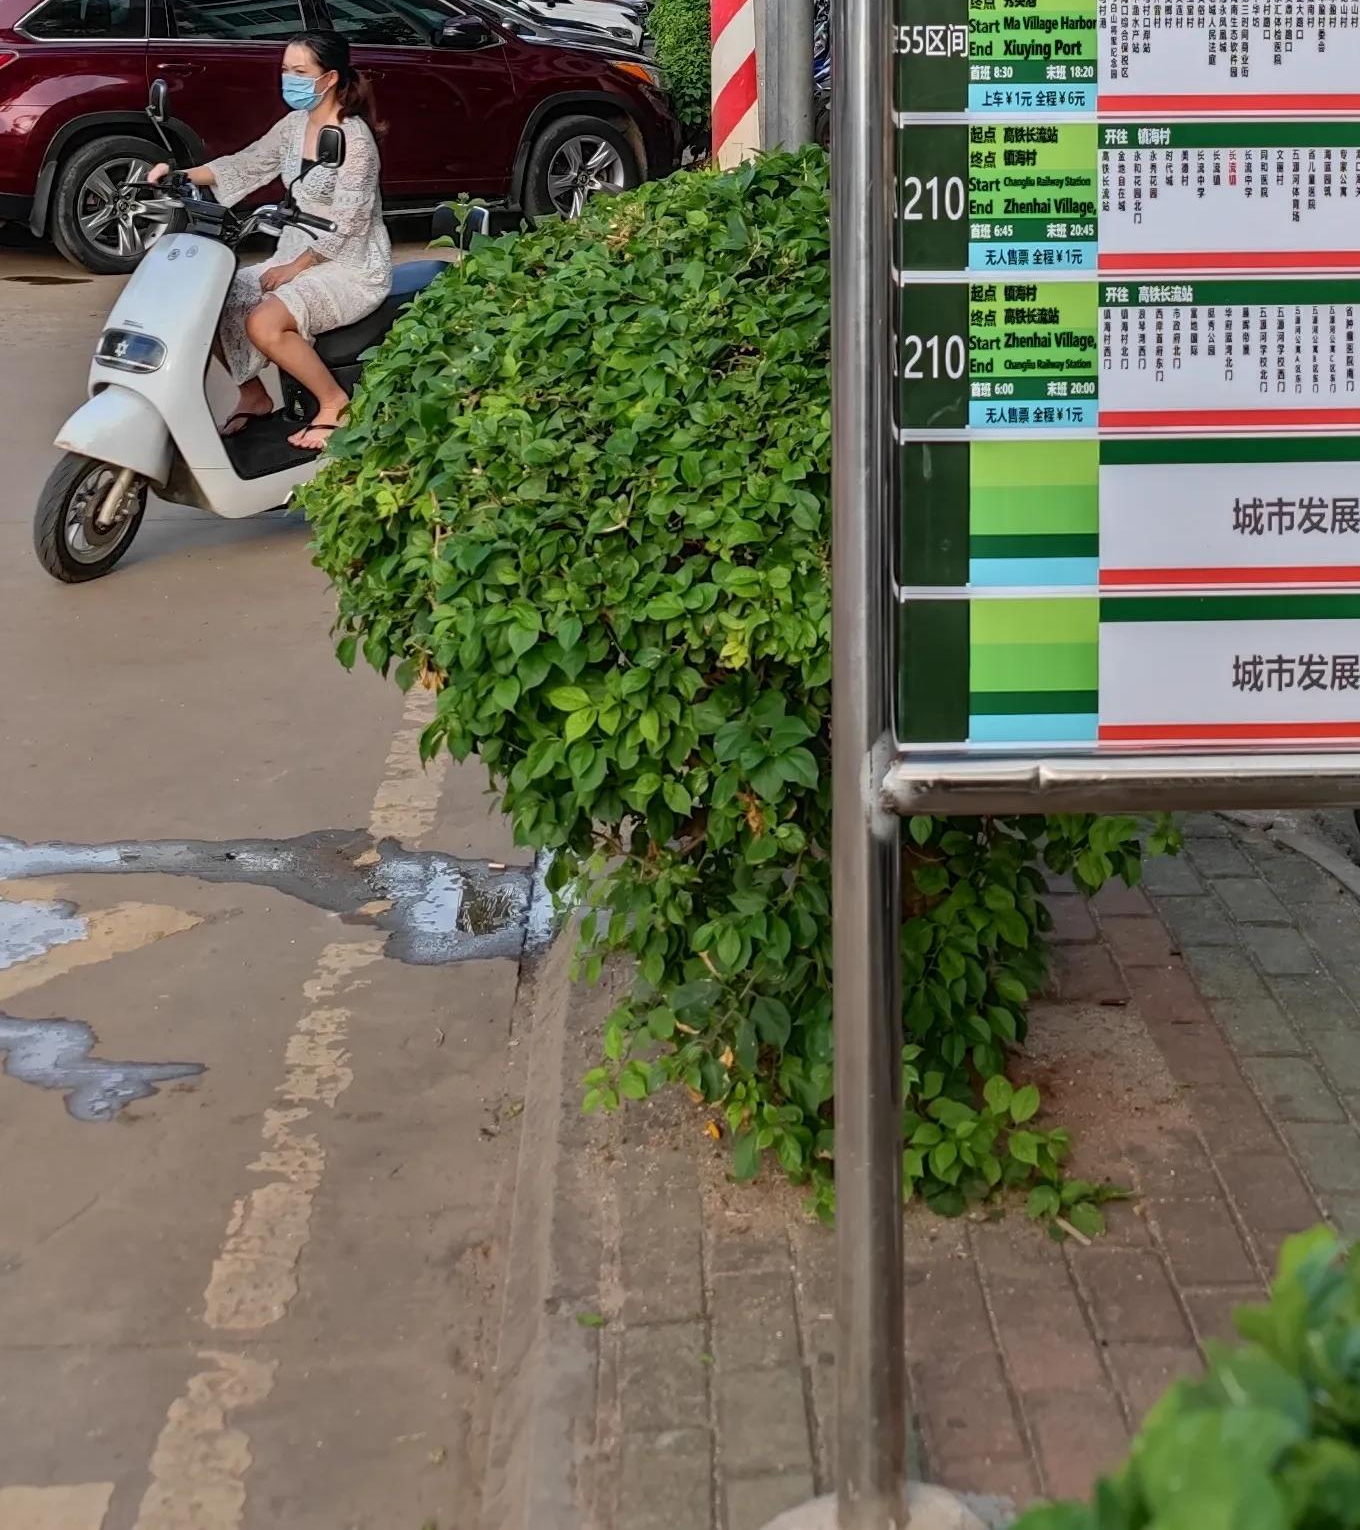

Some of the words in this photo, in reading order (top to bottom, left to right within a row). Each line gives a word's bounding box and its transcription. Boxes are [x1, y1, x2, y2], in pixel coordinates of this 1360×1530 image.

[969, 19, 1000, 33] Start
[1004, 17, 1020, 31] Ma
[1022, 16, 1058, 34] Village
[1061, 16, 1097, 29] Harbor
[900, 24, 968, 57] 55区间
[969, 42, 992, 57] End
[1003, 40, 1051, 60] Xiuying
[1055, 40, 1082, 56] Port
[994, 67, 1013, 79] 8:30
[1070, 66, 1094, 78] 18:20
[971, 127, 996, 143] 起点
[1003, 126, 1058, 143] 高铁长流站
[1105, 128, 1128, 145] 开往
[1138, 128, 1171, 145] 镇海村
[971, 151, 996, 168] 终点
[1004, 150, 1037, 167] 镇海村
[969, 178, 1000, 192] Start
[903, 176, 965, 221] 210
[970, 200, 993, 215] End
[1004, 198, 1051, 213] Zhenhai
[994, 225, 1013, 237] 6:45
[1070, 225, 1094, 237] 20:45
[985, 250, 1029, 265] 无人售票
[971, 285, 996, 302] 起点
[1004, 285, 1037, 302] 镇海村
[1106, 287, 1129, 303] 开往
[1138, 286, 1193, 303] 高铁长流站
[971, 310, 996, 326] 终点
[1004, 308, 1059, 324] 高铁长流站
[969, 336, 1001, 350] Start
[1004, 332, 1051, 348] Zhenhai
[904, 334, 965, 379] 210
[970, 358, 993, 373] End
[995, 382, 1014, 395] 6:00
[1047, 382, 1067, 396] 末班
[1071, 382, 1095, 394] 20:00
[986, 407, 1029, 423] 无人售票
[1232, 496, 1360, 536] 城市发展
[1232, 654, 1360, 692] 城市发展
